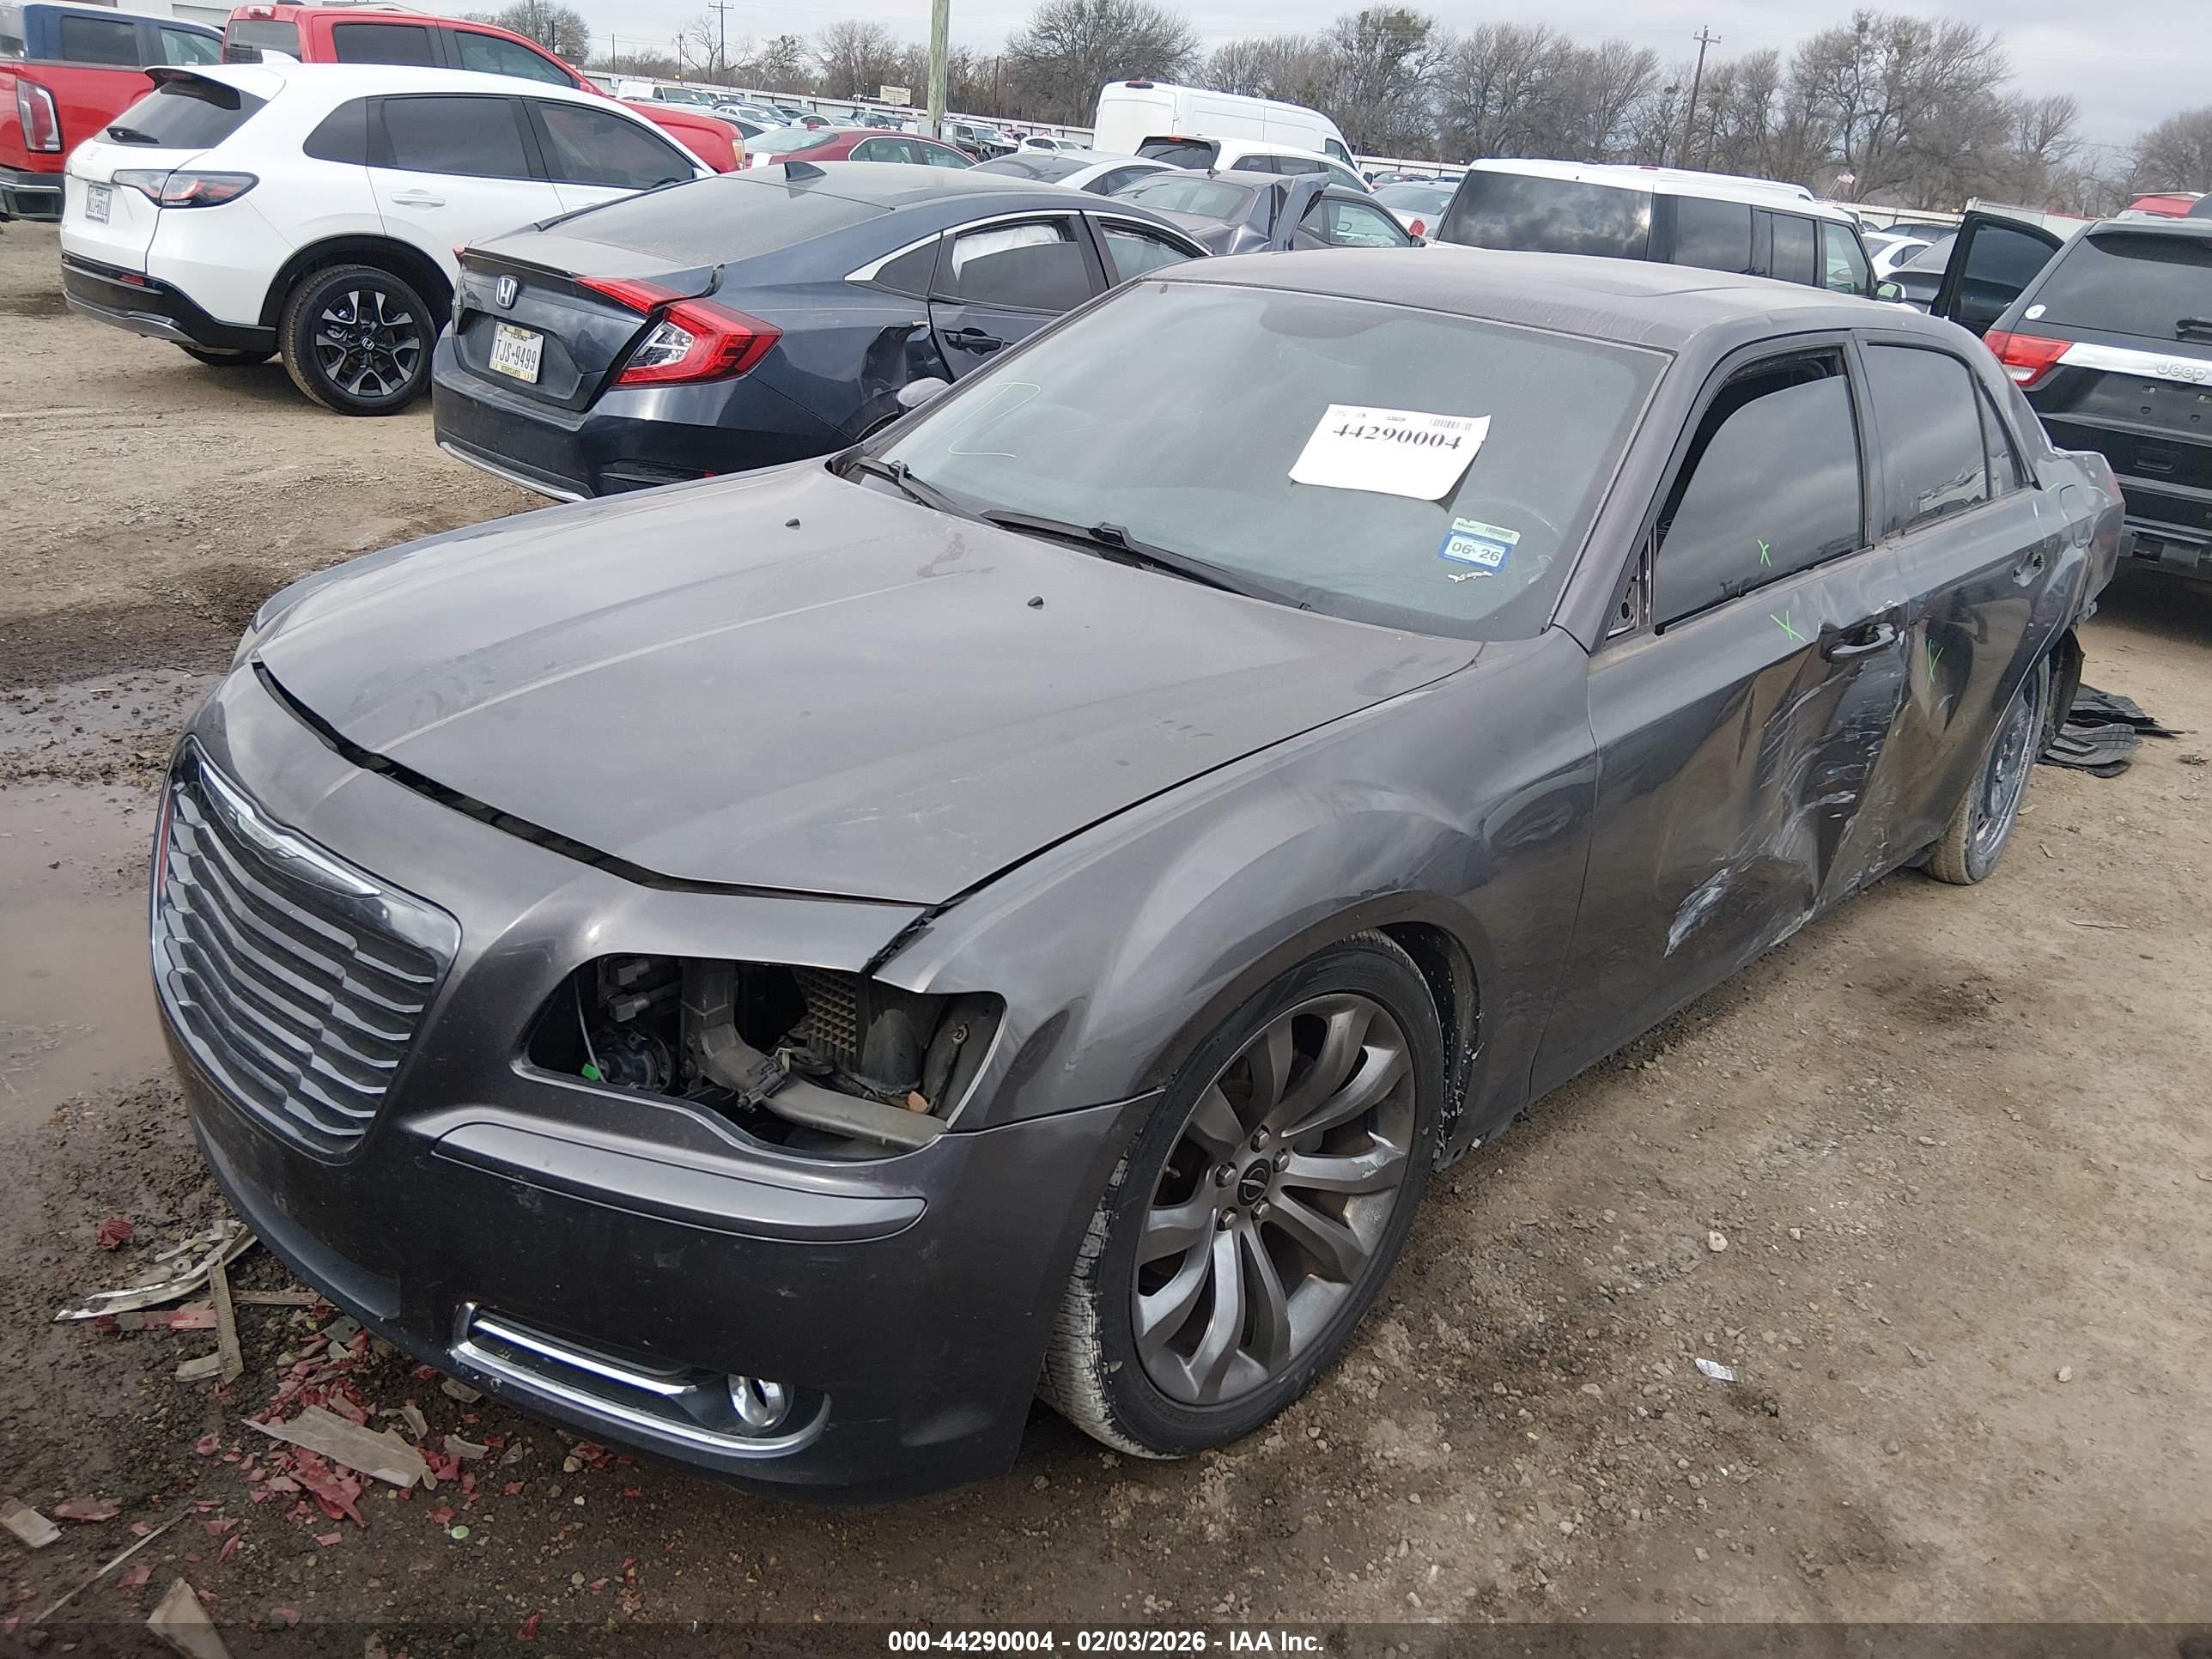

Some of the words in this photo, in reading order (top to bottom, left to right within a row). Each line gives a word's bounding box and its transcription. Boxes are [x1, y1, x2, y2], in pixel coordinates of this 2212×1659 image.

[2157, 361, 2206, 382] Jeep
[1333, 423, 1462, 449] 44290004
[1479, 549, 1501, 562] 26
